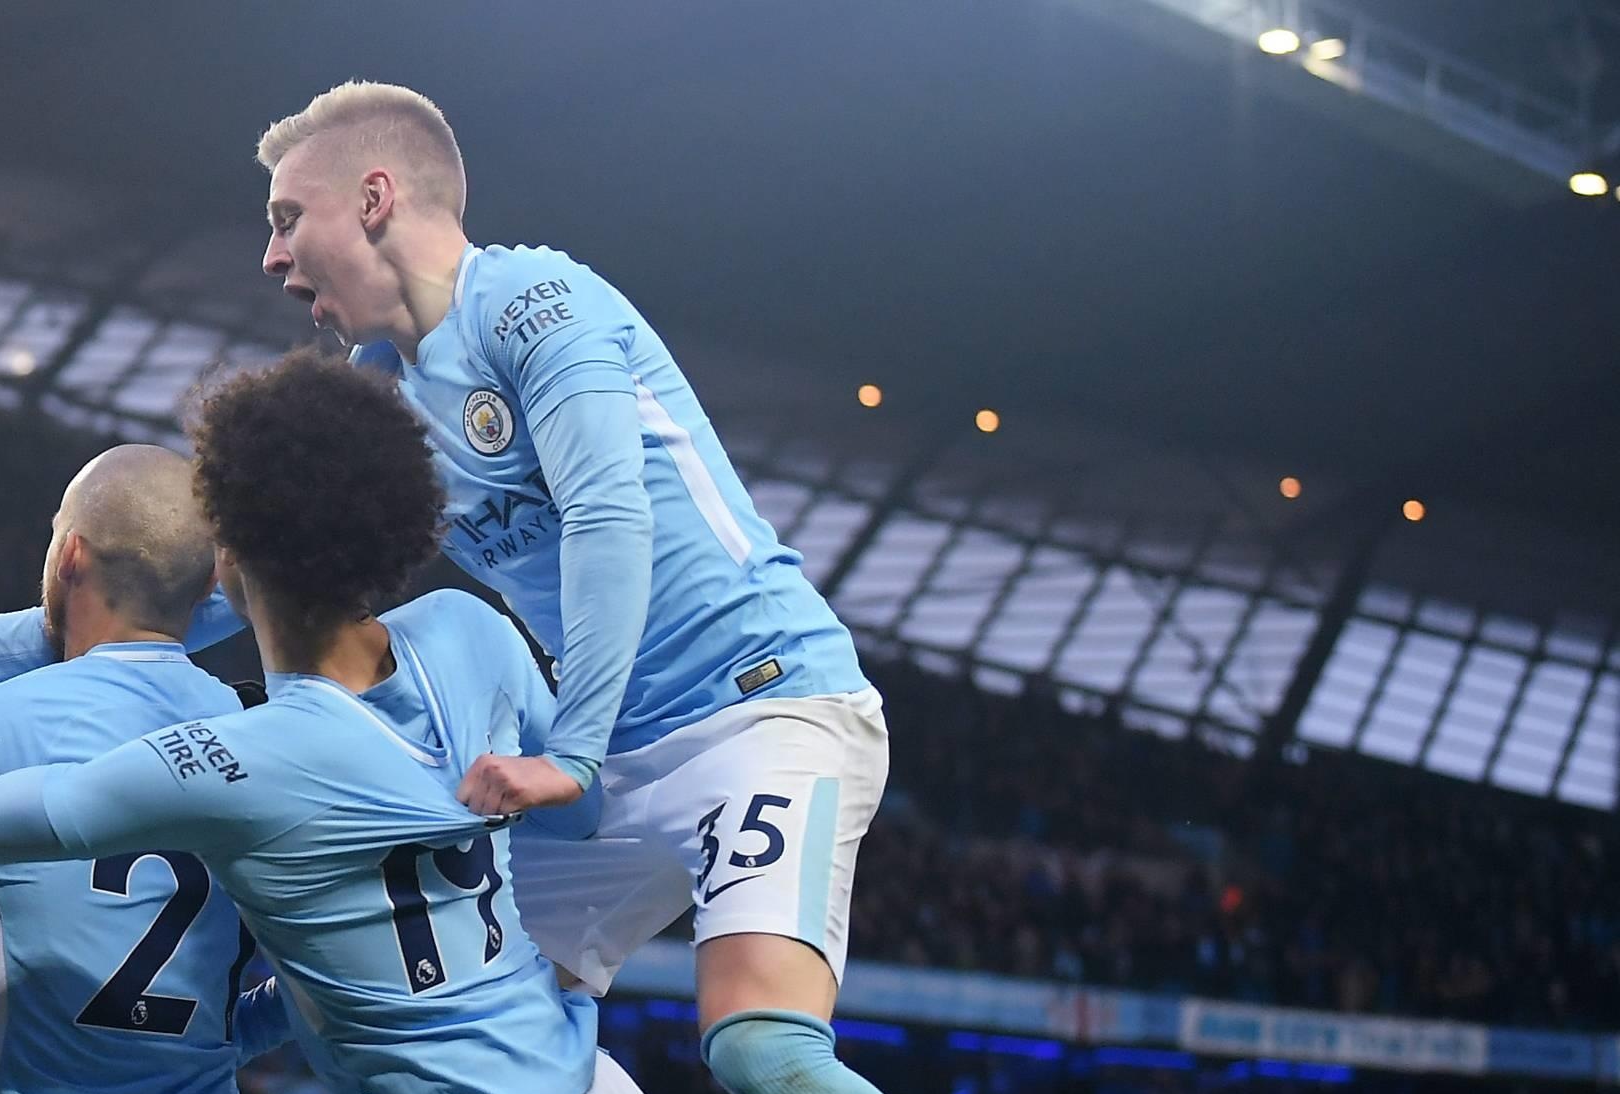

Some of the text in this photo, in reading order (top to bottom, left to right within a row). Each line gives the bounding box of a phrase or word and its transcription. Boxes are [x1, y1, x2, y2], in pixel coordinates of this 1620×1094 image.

[494, 279, 572, 341] NEXEN
[511, 302, 574, 344] TIRE
[158, 730, 206, 780] TIRE
